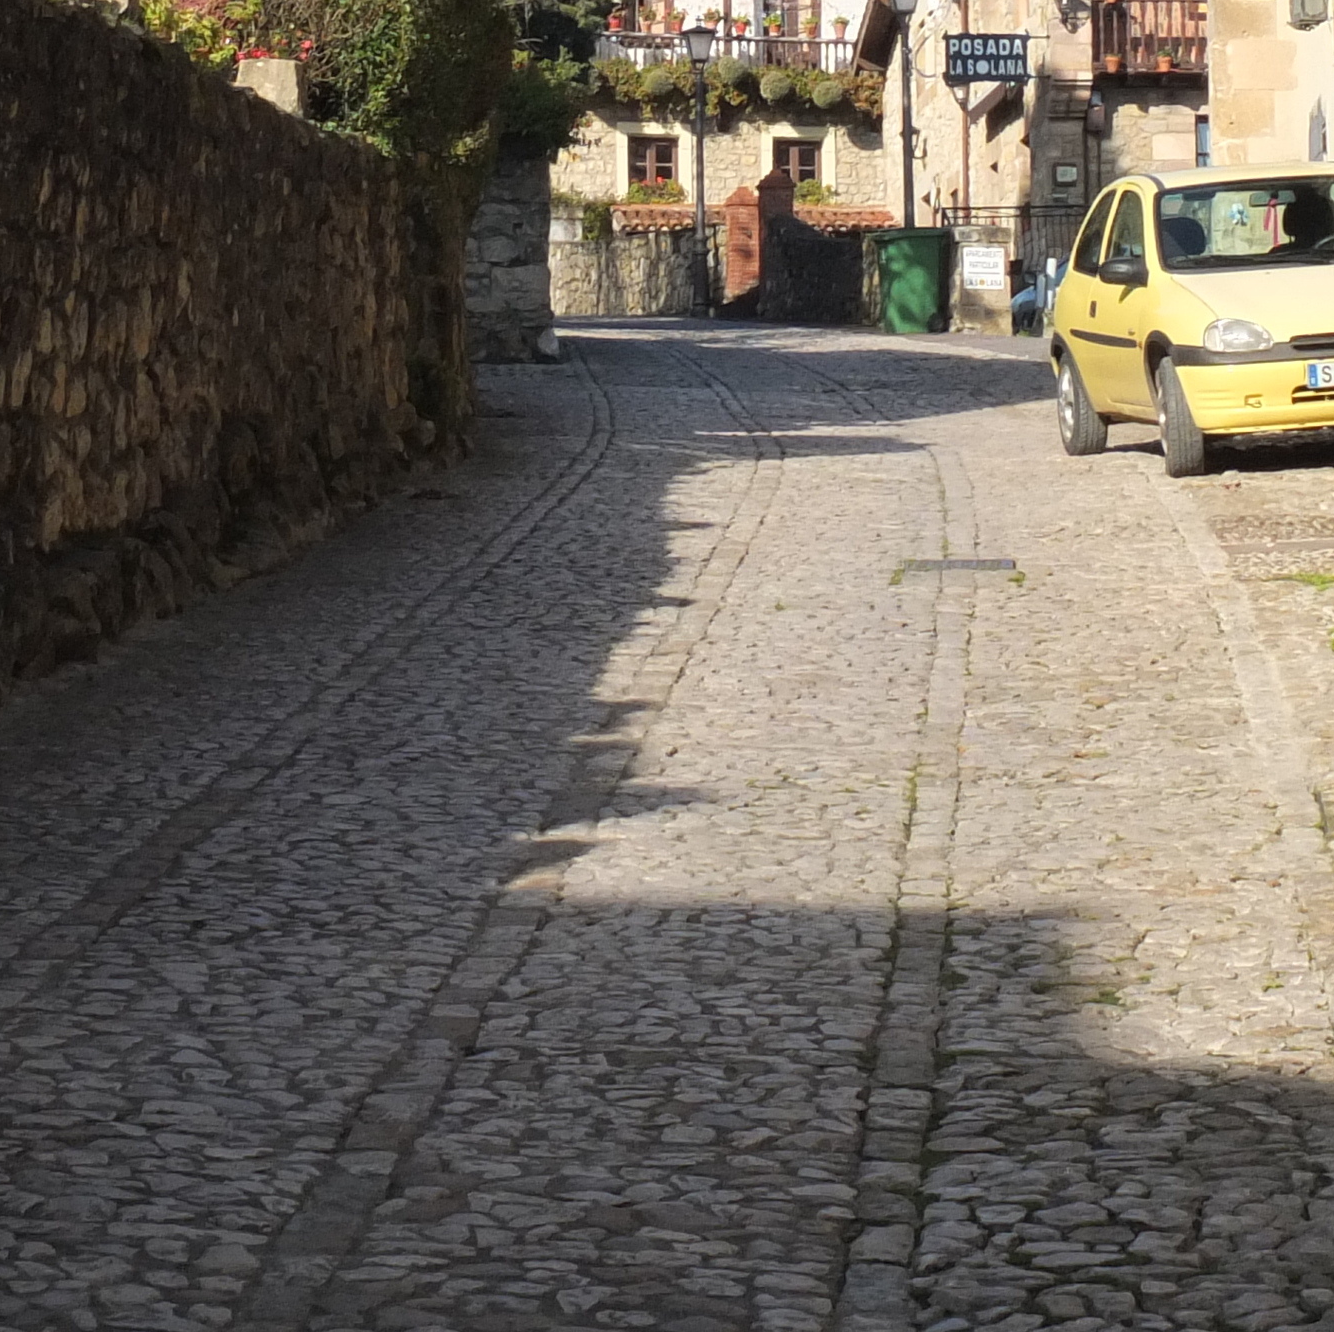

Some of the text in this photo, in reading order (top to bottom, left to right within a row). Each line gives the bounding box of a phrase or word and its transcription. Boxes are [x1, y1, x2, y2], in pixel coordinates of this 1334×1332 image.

[949, 39, 1024, 56] POSADA
[949, 59, 963, 76] LA
[1322, 365, 1332, 383] S
